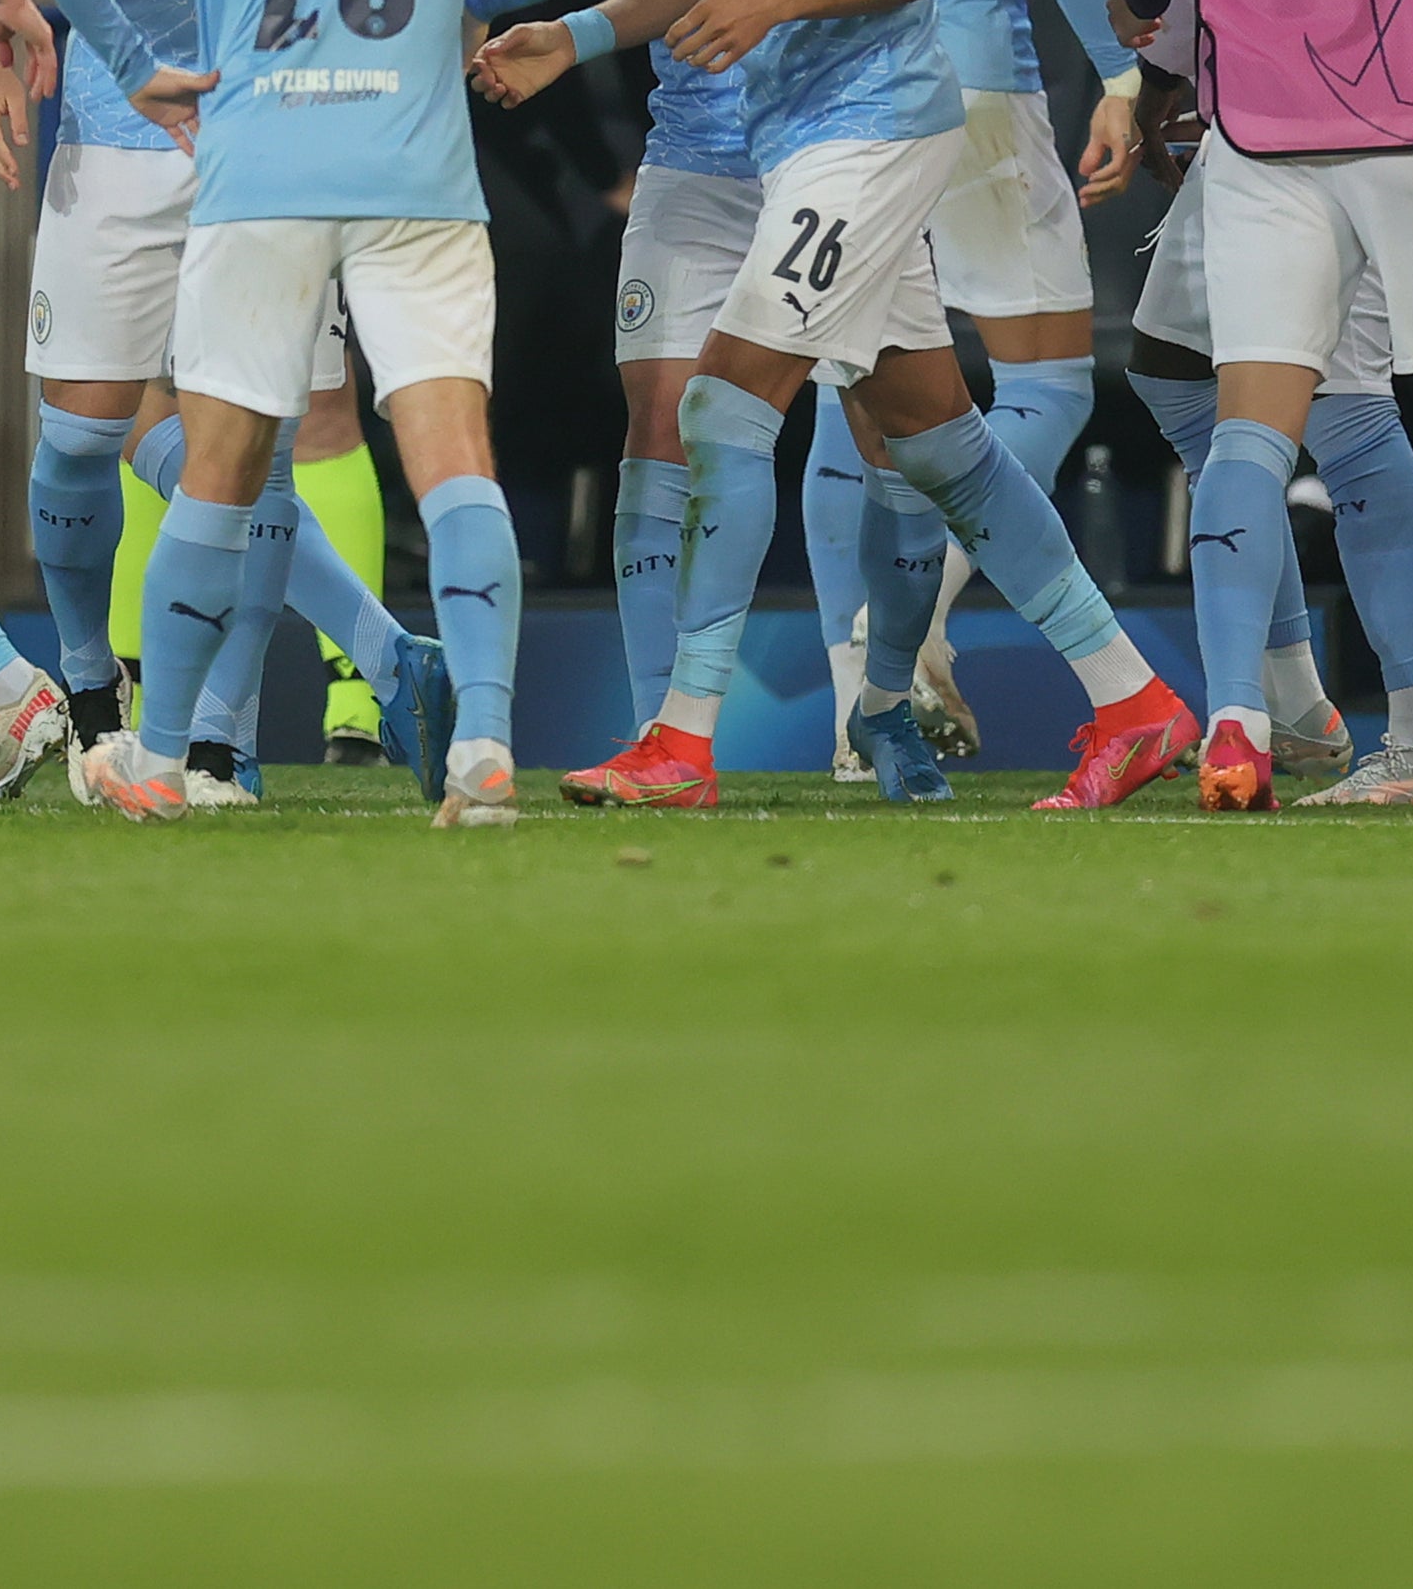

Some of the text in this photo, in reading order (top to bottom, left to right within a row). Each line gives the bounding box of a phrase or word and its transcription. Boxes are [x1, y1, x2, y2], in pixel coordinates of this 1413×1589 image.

[334, 68, 400, 94] GIVING
[771, 207, 848, 291] 26
[39, 507, 96, 529] CITY
[622, 553, 676, 579] CITY
